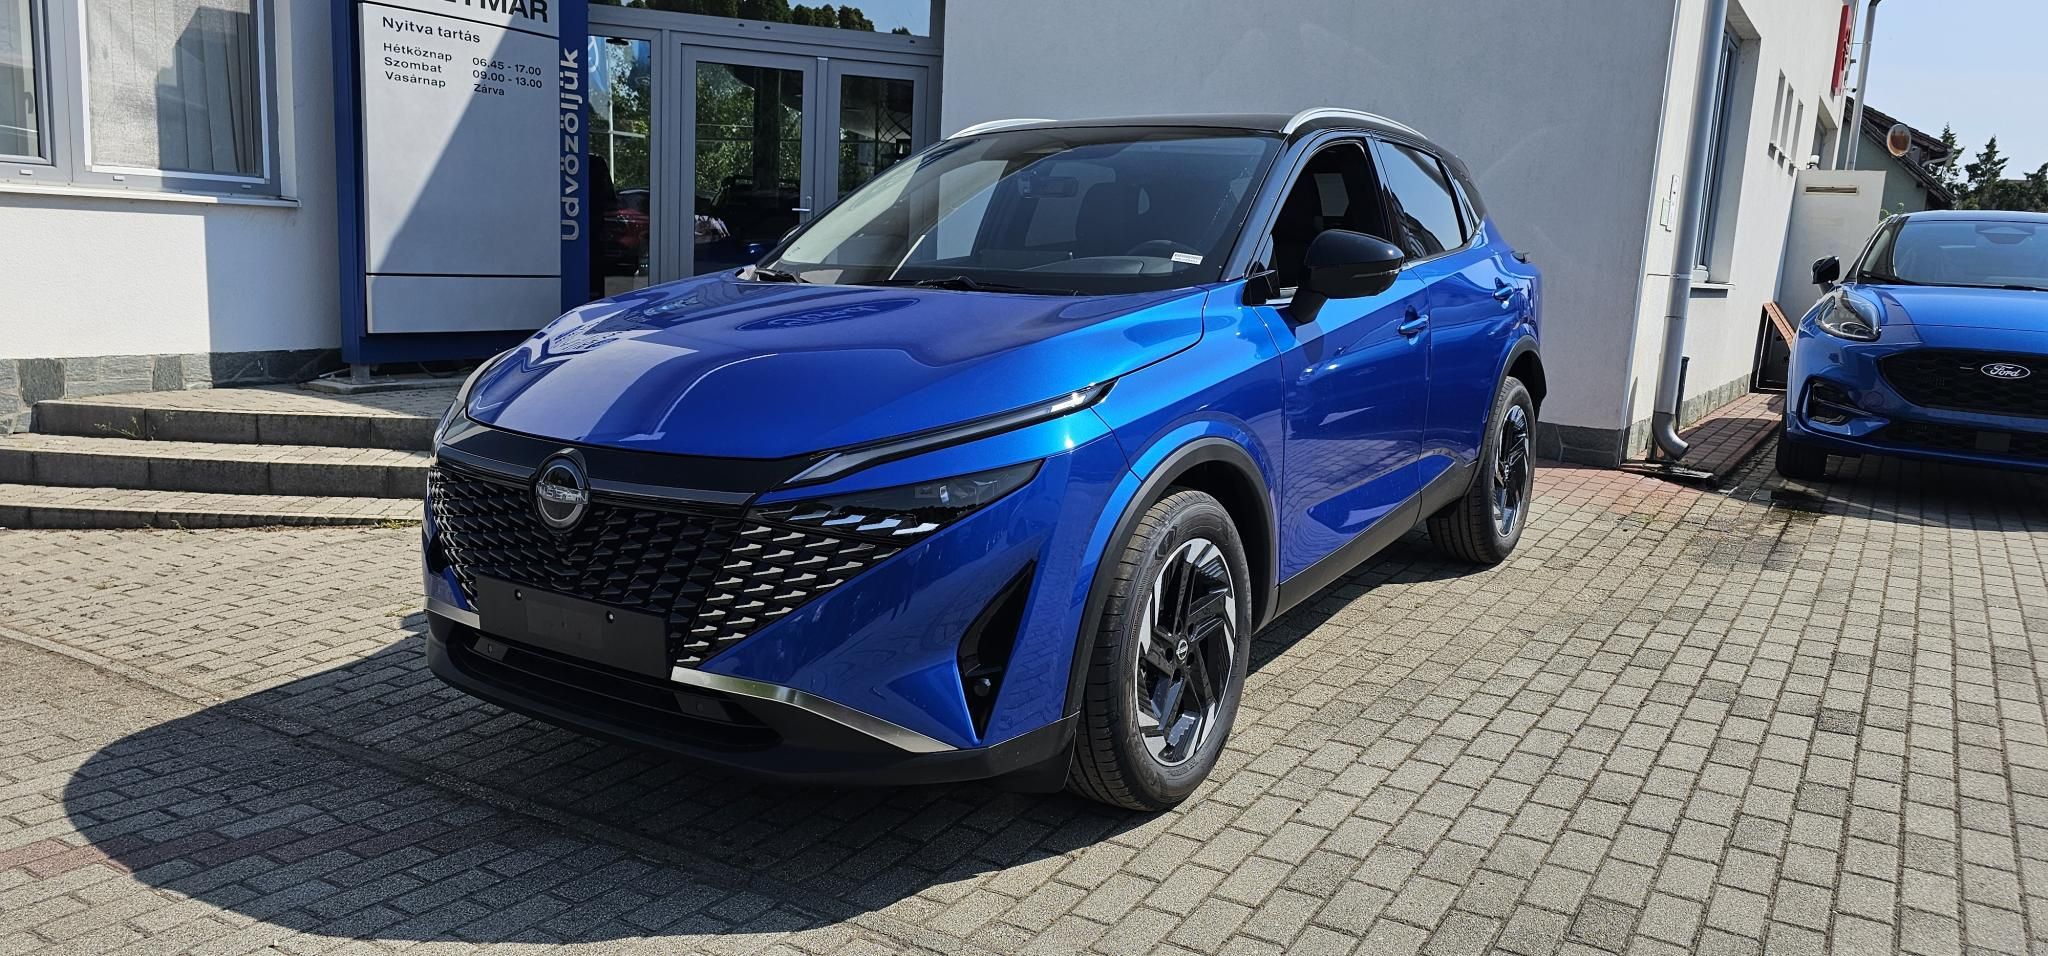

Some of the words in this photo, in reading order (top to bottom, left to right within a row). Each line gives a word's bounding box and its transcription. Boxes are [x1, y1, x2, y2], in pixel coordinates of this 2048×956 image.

[382, 16, 433, 35] Nyitva
[438, 26, 481, 43] tartás
[383, 42, 452, 62] Hétköznap
[472, 57, 505, 70] 06.45
[514, 63, 542, 76] 17.00
[384, 56, 442, 73] Szombat
[472, 69, 505, 82] 09.00
[515, 76, 543, 89] 13.00
[385, 70, 446, 88] Vasárnap
[473, 83, 505, 96] Zárva
[1990, 365, 2021, 377] Ford
[536, 480, 589, 505] NISSAN
